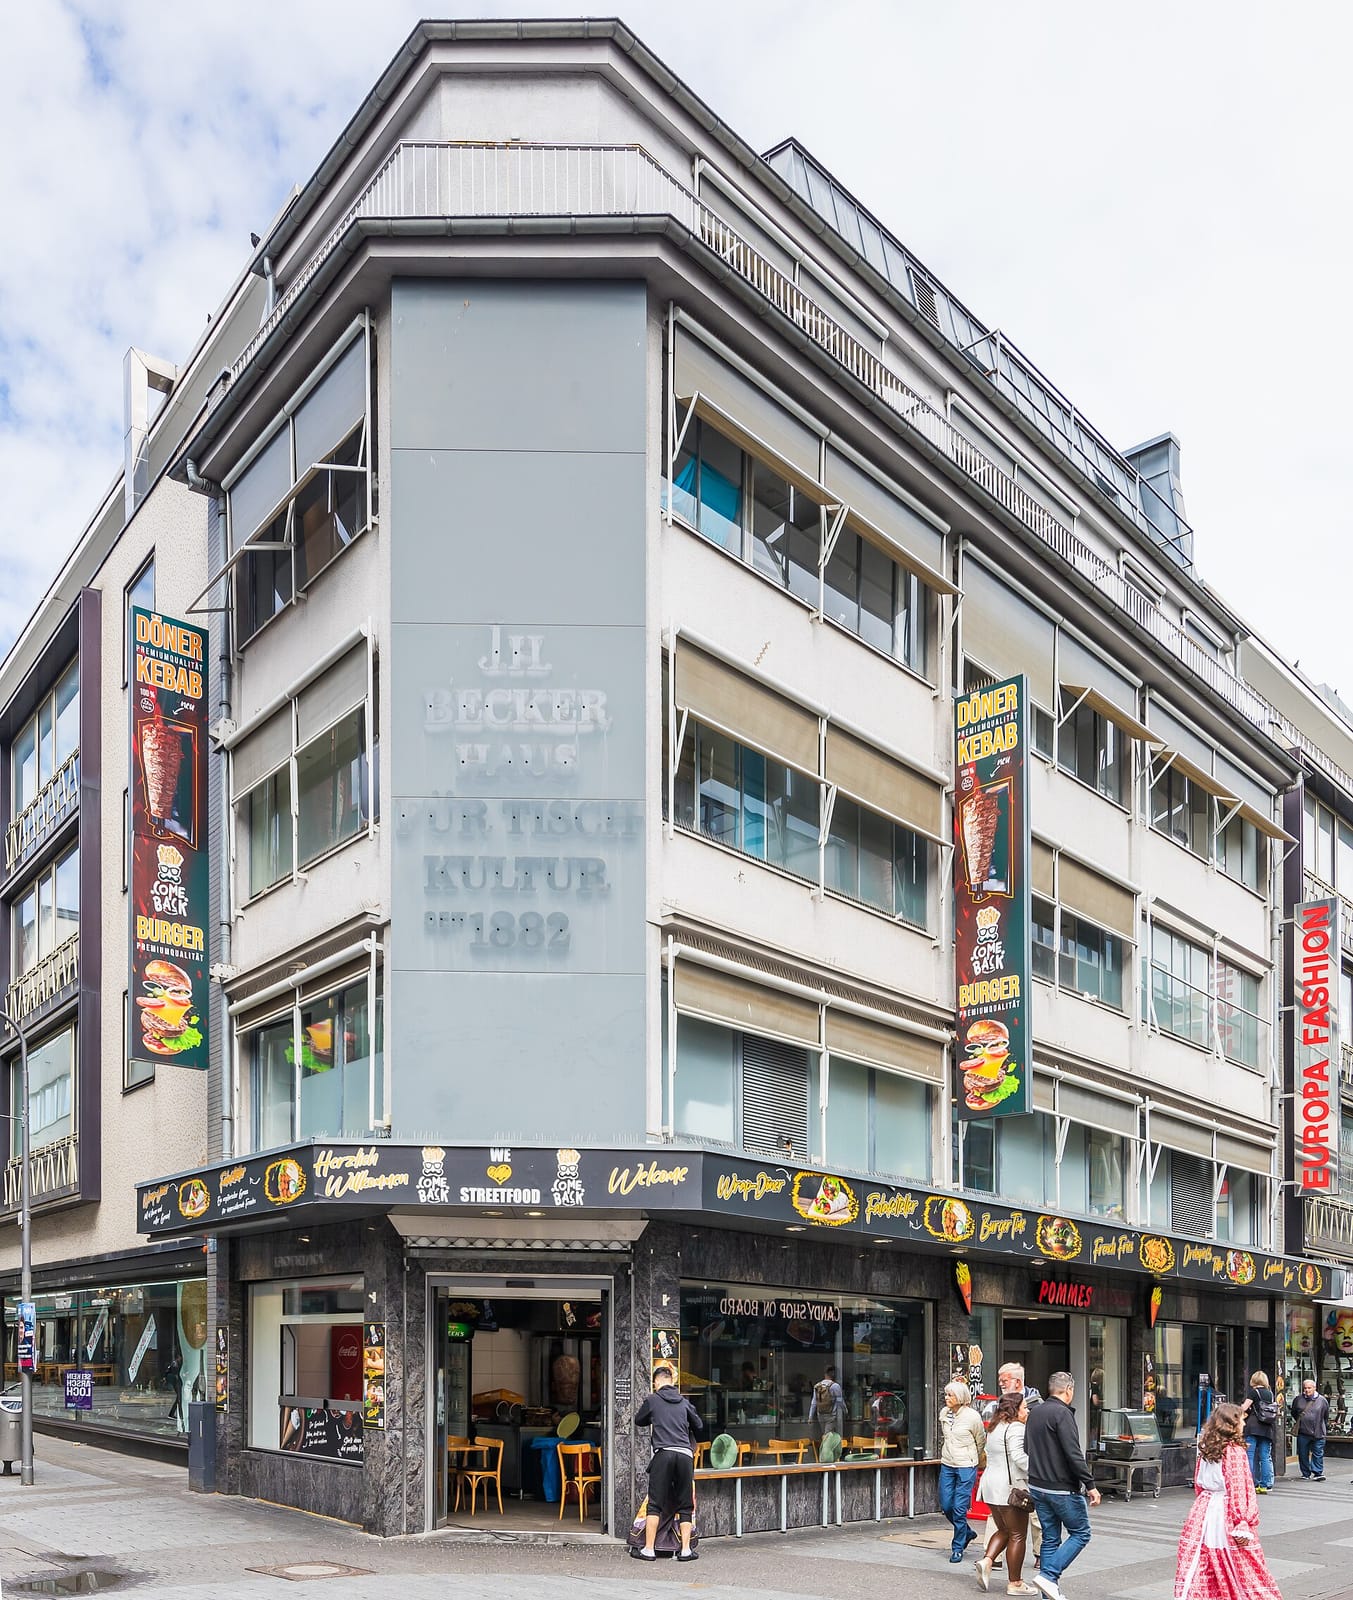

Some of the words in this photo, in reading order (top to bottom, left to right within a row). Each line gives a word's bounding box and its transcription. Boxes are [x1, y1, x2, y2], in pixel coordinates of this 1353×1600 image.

[136, 613, 203, 662] DÖNER
[136, 644, 203, 672] PREMIUMQUALITÄT
[137, 654, 203, 699] KEBAB
[423, 688, 612, 729] BECKER
[957, 683, 1018, 730] DÖNER
[957, 711, 1018, 740] PREMIUMQUALITÄT
[957, 722, 1018, 767] KEBAB
[424, 856, 611, 892] KULTUR
[152, 881, 187, 900] COME
[152, 897, 188, 917] BACK
[136, 914, 204, 951] BURGER
[469, 911, 570, 949] 1882
[136, 941, 204, 963] PREMIUMQUALITÄT
[972, 941, 1005, 961] COME
[972, 956, 1004, 976] BACK
[1302, 905, 1330, 1046] FASHION
[959, 975, 1021, 1009] BURGER
[959, 999, 1021, 1018] PREMIUMQUALITÄT
[1302, 1059, 1330, 1190] EUROPA
[313, 1146, 379, 1178] Herzlich
[490, 1147, 511, 1163] WE
[325, 1169, 409, 1199] Willkommen
[417, 1176, 449, 1190] COME
[552, 1178, 584, 1193] COME
[608, 1160, 689, 1196] Welcome
[418, 1188, 449, 1203] BACK
[459, 1187, 541, 1205] STREETFOOD
[553, 1192, 584, 1206] BACK
[978, 1212, 1013, 1243] Burger
[1039, 1280, 1093, 1307] POMMES
[968, 1382, 984, 1398] OME
